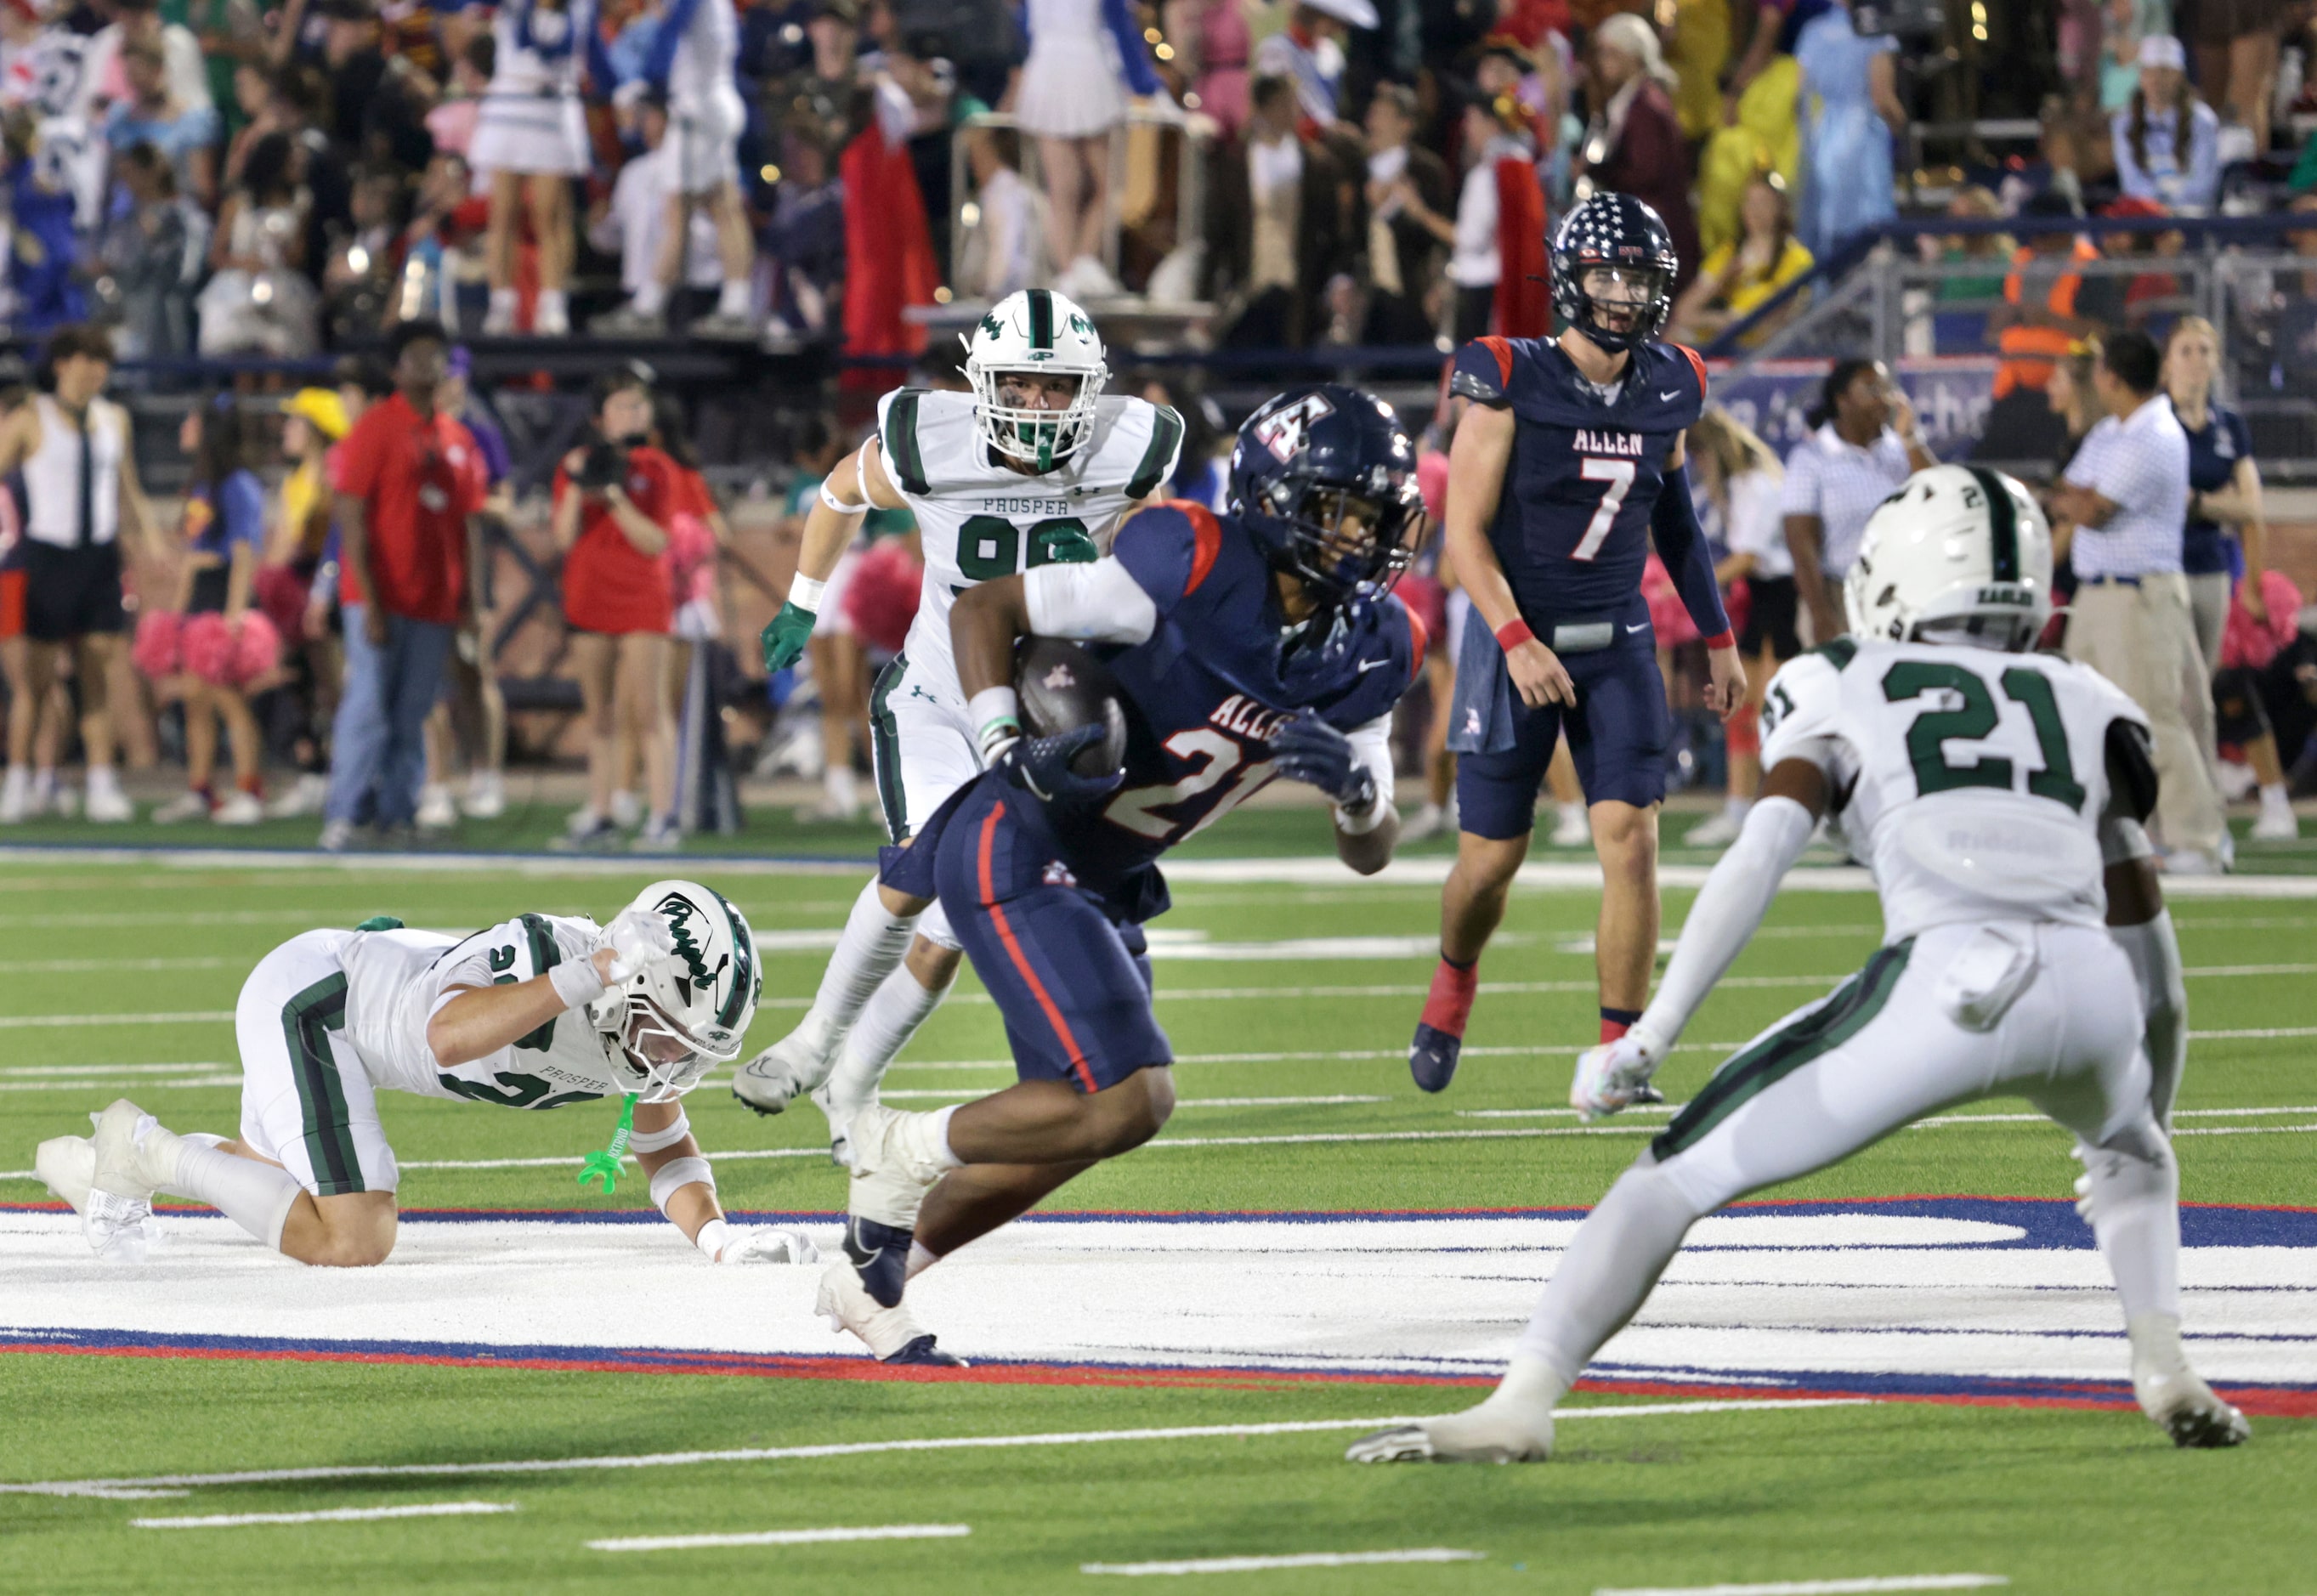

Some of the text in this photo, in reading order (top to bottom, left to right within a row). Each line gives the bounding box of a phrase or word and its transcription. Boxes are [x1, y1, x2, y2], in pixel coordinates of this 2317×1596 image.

[1572, 428, 1643, 456] ALLEN
[983, 497, 1068, 515] PROSPER
[1567, 456, 1638, 563] 7
[1209, 693, 1300, 743] ALLE
[1880, 660, 2087, 817] 21
[1103, 726, 1280, 845] 21
[490, 943, 519, 986] 2
[659, 900, 718, 991] Prosper
[539, 1065, 609, 1091] PROSPER
[606, 1127, 629, 1160] NXTRND
